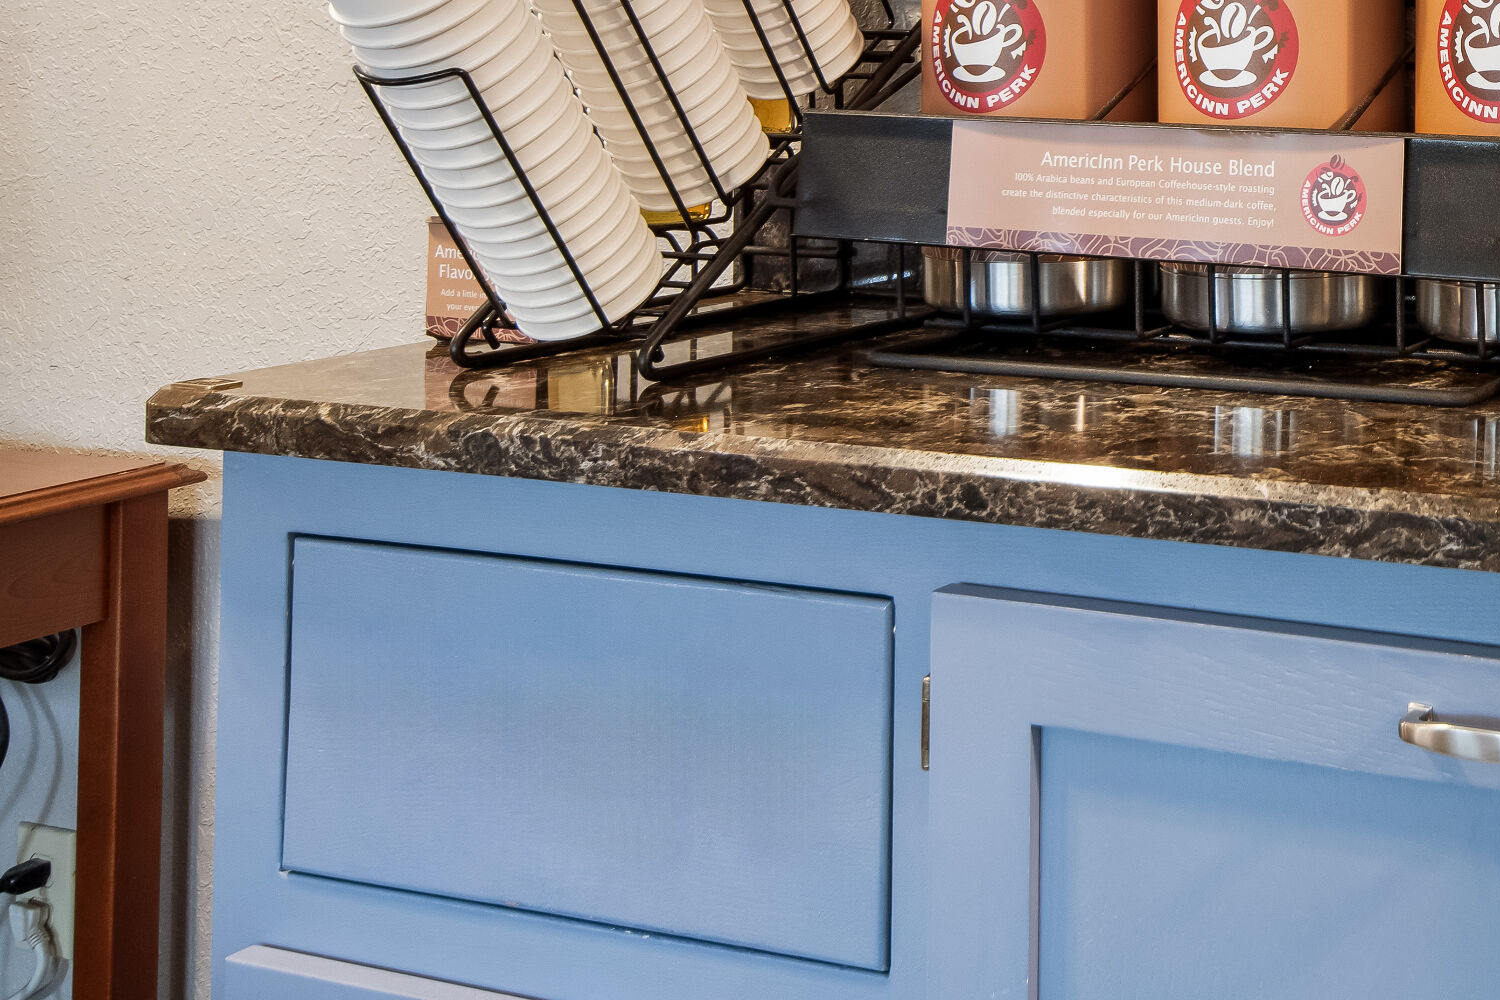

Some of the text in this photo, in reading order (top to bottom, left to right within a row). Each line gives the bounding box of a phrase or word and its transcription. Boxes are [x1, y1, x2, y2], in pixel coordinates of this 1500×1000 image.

[932, 10, 1037, 109] AMERICINN PERK
[1175, 11, 1290, 116] AMERICINN PERK
[1439, 10, 1498, 119] AMERICINN
[1041, 151, 1275, 177] AmericInn Perk House Blend
[1015, 173, 1275, 196] 100% Arabica beans and European Coffeehouse-style roasting
[1002, 189, 1276, 212] create the distinctive characteristics of this medium-dark coffee,
[1302, 180, 1362, 235] AMERICINN PERK
[1052, 206, 1086, 216] blended
[1088, 209, 1130, 220] especially
[1133, 210, 1145, 220] for
[1212, 216, 1245, 226] guests.
[1248, 217, 1275, 228] Enjoy!
[439, 264, 477, 280] Flavo
[441, 288, 455, 297] Add
[463, 290, 478, 298] little
